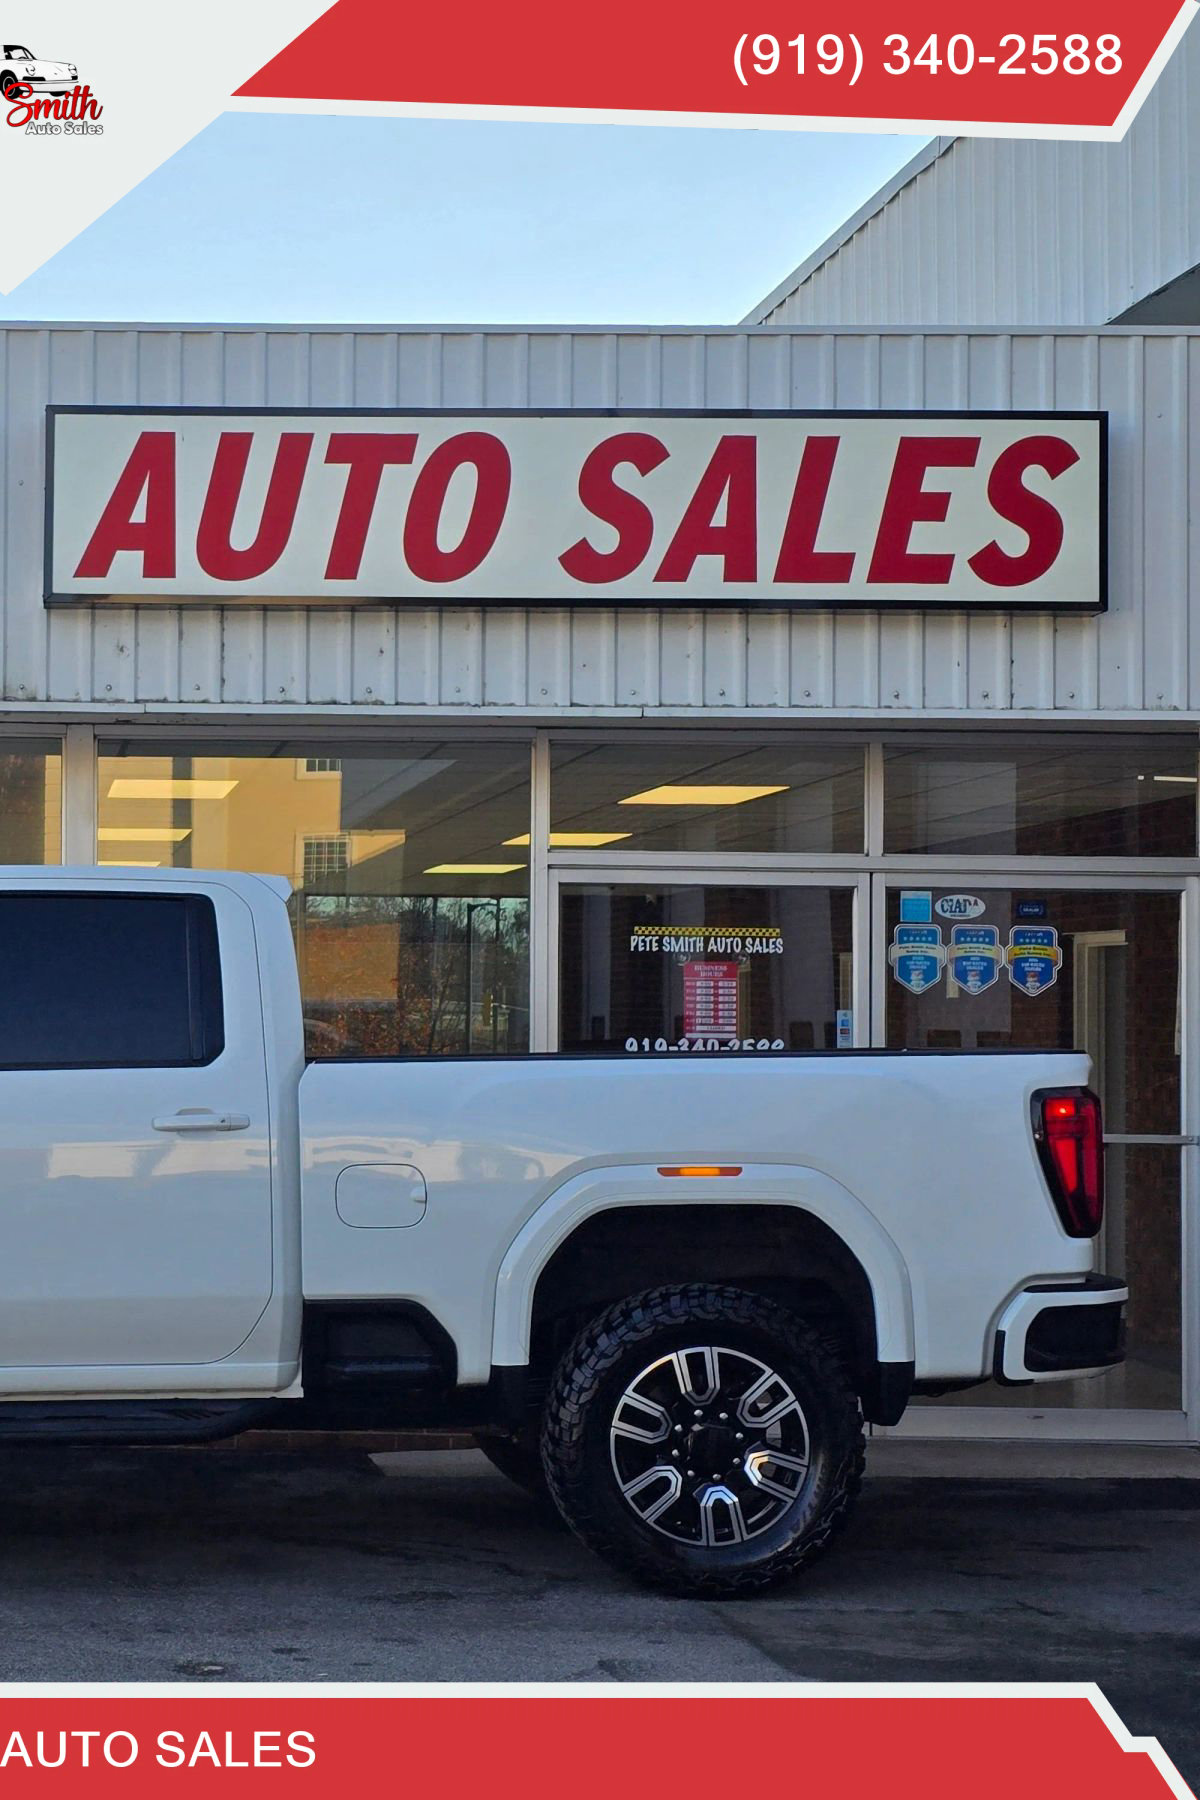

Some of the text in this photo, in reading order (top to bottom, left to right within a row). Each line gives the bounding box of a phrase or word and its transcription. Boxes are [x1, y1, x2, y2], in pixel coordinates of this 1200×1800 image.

[75, 432, 1079, 587] AUTO SALES
[630, 936, 783, 954] PETE SMITH AUTO SALES
